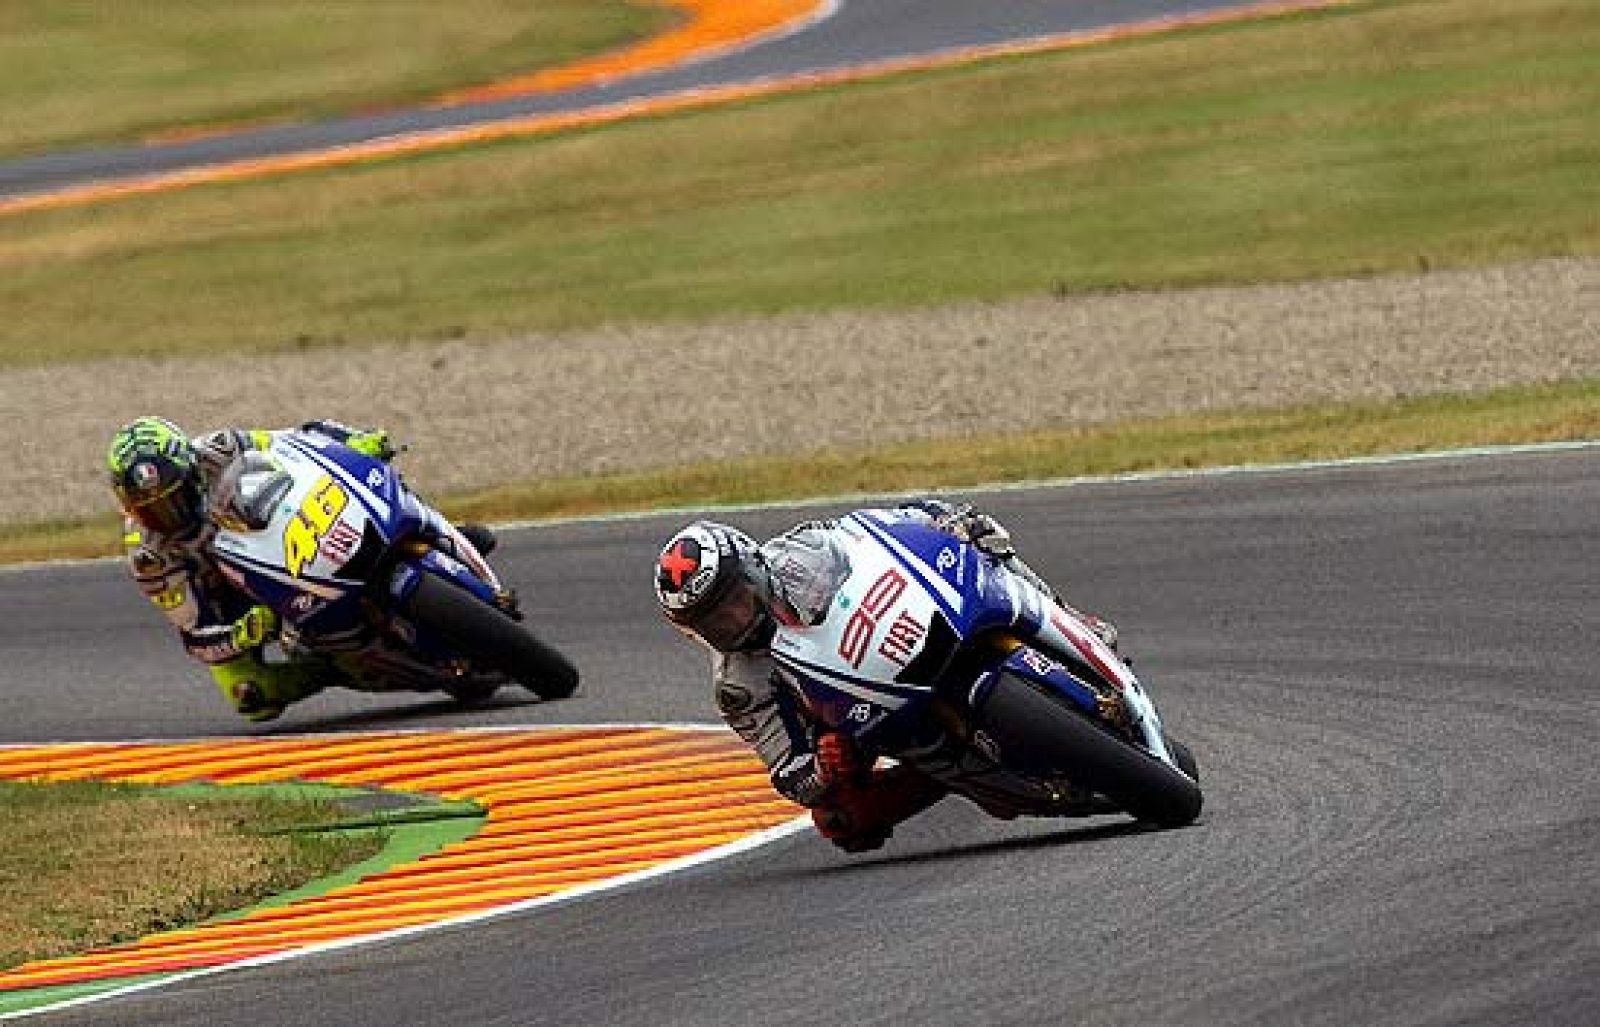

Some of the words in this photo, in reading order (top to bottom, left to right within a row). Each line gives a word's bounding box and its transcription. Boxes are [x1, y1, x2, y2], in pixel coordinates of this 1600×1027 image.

[284, 473, 349, 578] 46
[838, 567, 907, 669] 99
[879, 610, 926, 666] FIAT
